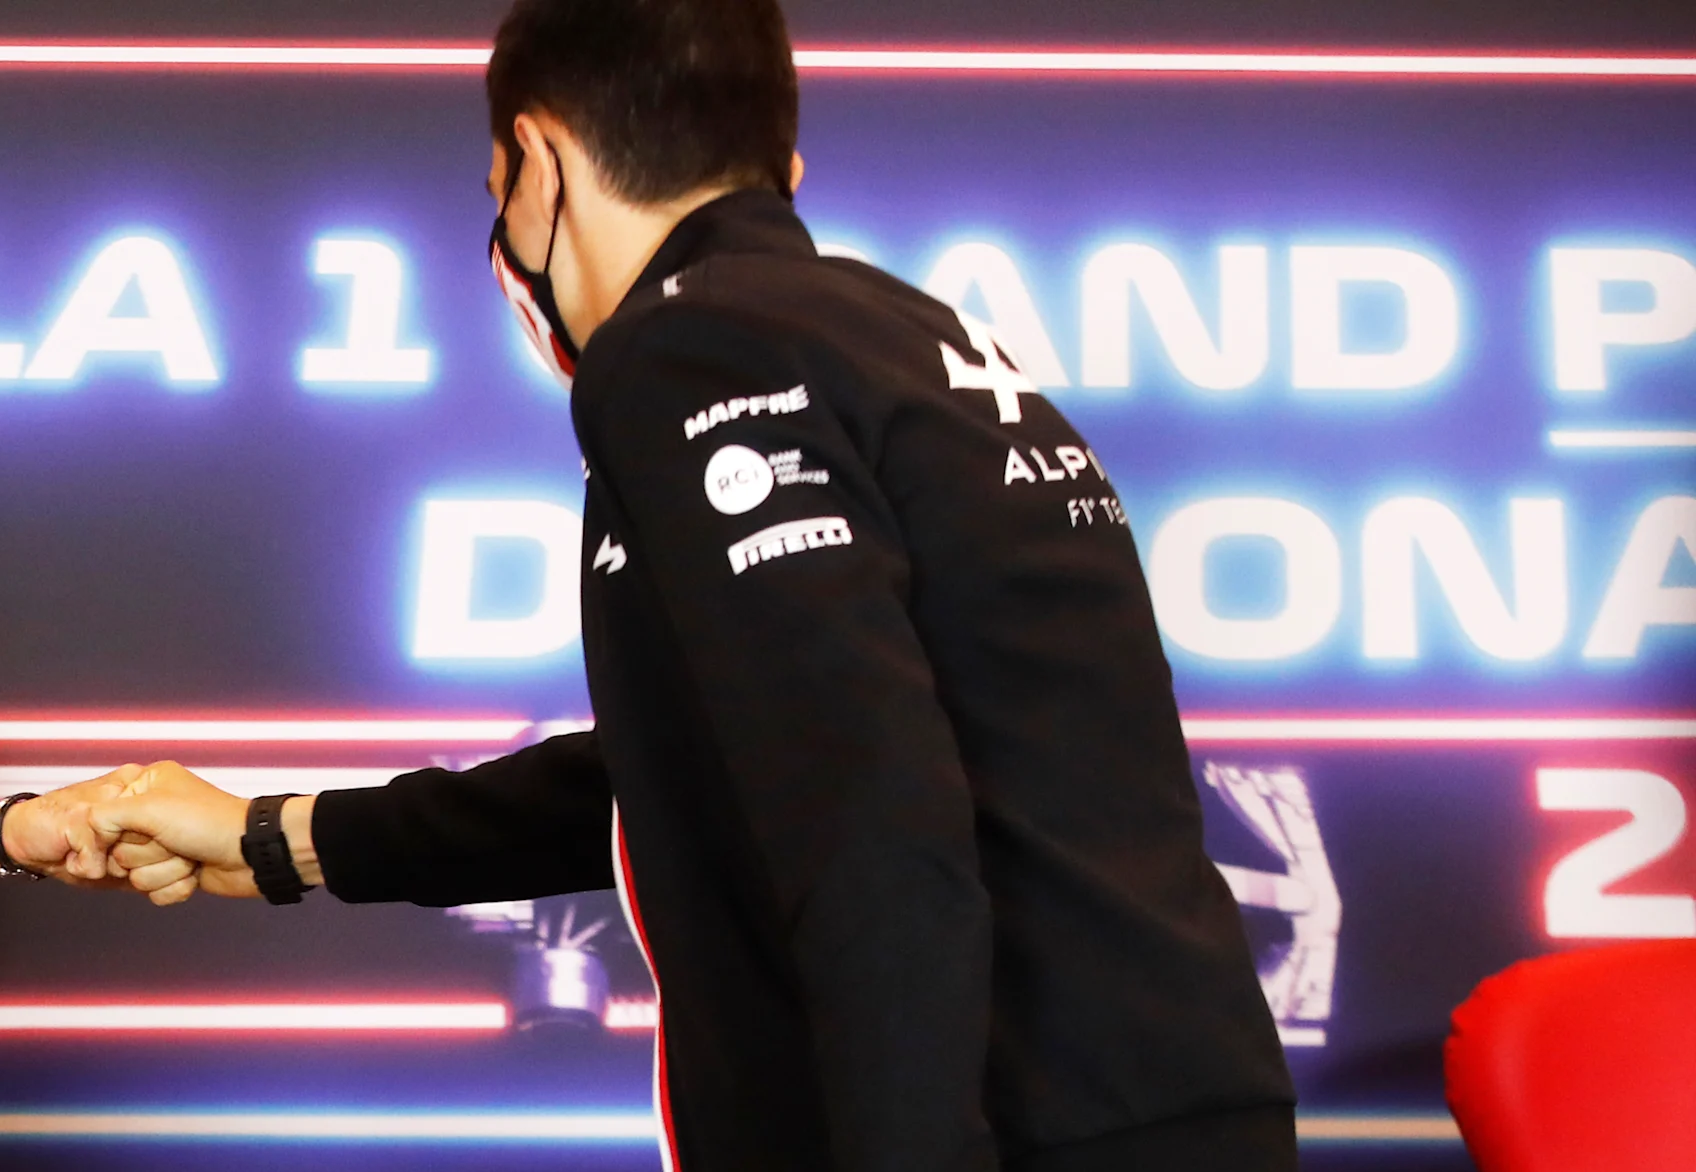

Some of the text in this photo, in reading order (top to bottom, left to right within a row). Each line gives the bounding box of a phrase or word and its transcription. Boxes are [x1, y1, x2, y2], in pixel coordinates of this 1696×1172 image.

[300, 238, 432, 384] 1
[812, 240, 1462, 391] AND
[683, 384, 810, 440] MAPFRE
[1003, 445, 1106, 486] ALPI
[727, 516, 854, 576] PIRELLI
